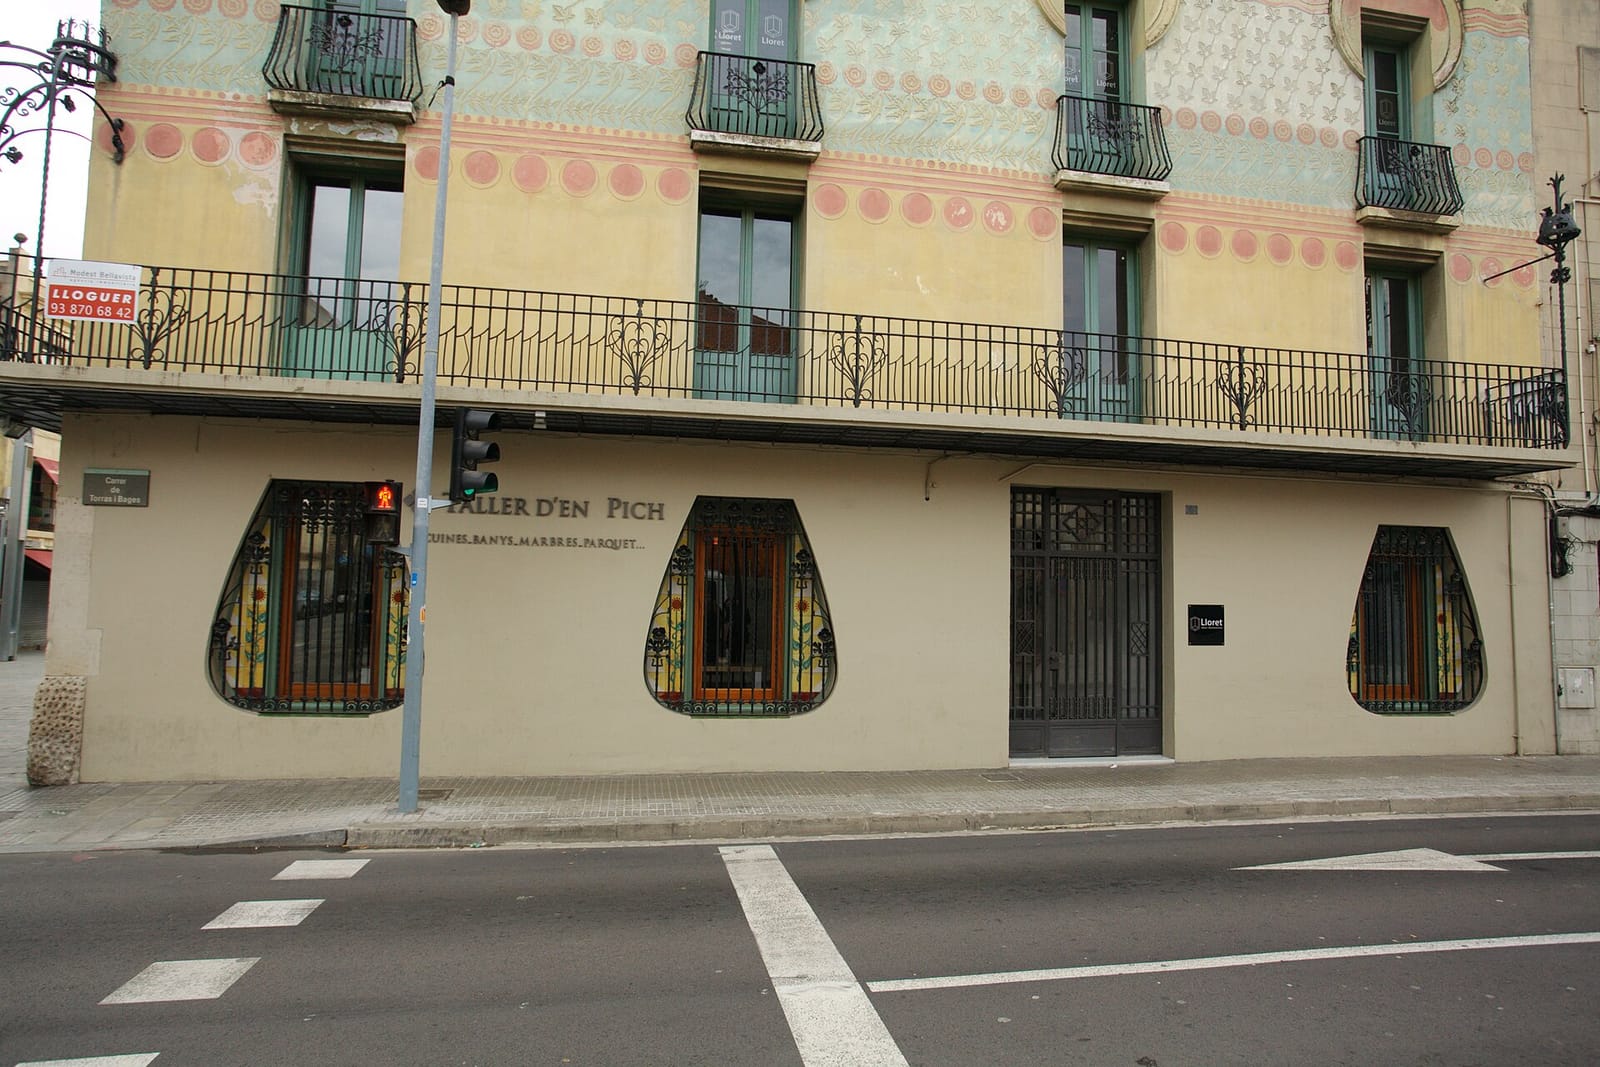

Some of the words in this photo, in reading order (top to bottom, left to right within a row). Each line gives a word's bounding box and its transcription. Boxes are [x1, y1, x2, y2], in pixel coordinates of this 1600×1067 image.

[718, 31, 742, 41] Lloret
[761, 36, 785, 47] Lloret
[1064, 75, 1080, 83] oret
[1096, 79, 1116, 89] Lloret
[52, 288, 133, 304] LLOGUER
[51, 302, 66, 314] 93
[69, 303, 93, 316] 870
[96, 305, 112, 317] 68
[115, 307, 132, 319] 42
[105, 476, 127, 485] Carrer
[110, 486, 121, 494] de
[89, 494, 113, 503] Torras
[117, 495, 141, 505] Bages
[535, 496, 590, 518] D'EN
[1200, 617, 1223, 627] Lloret
